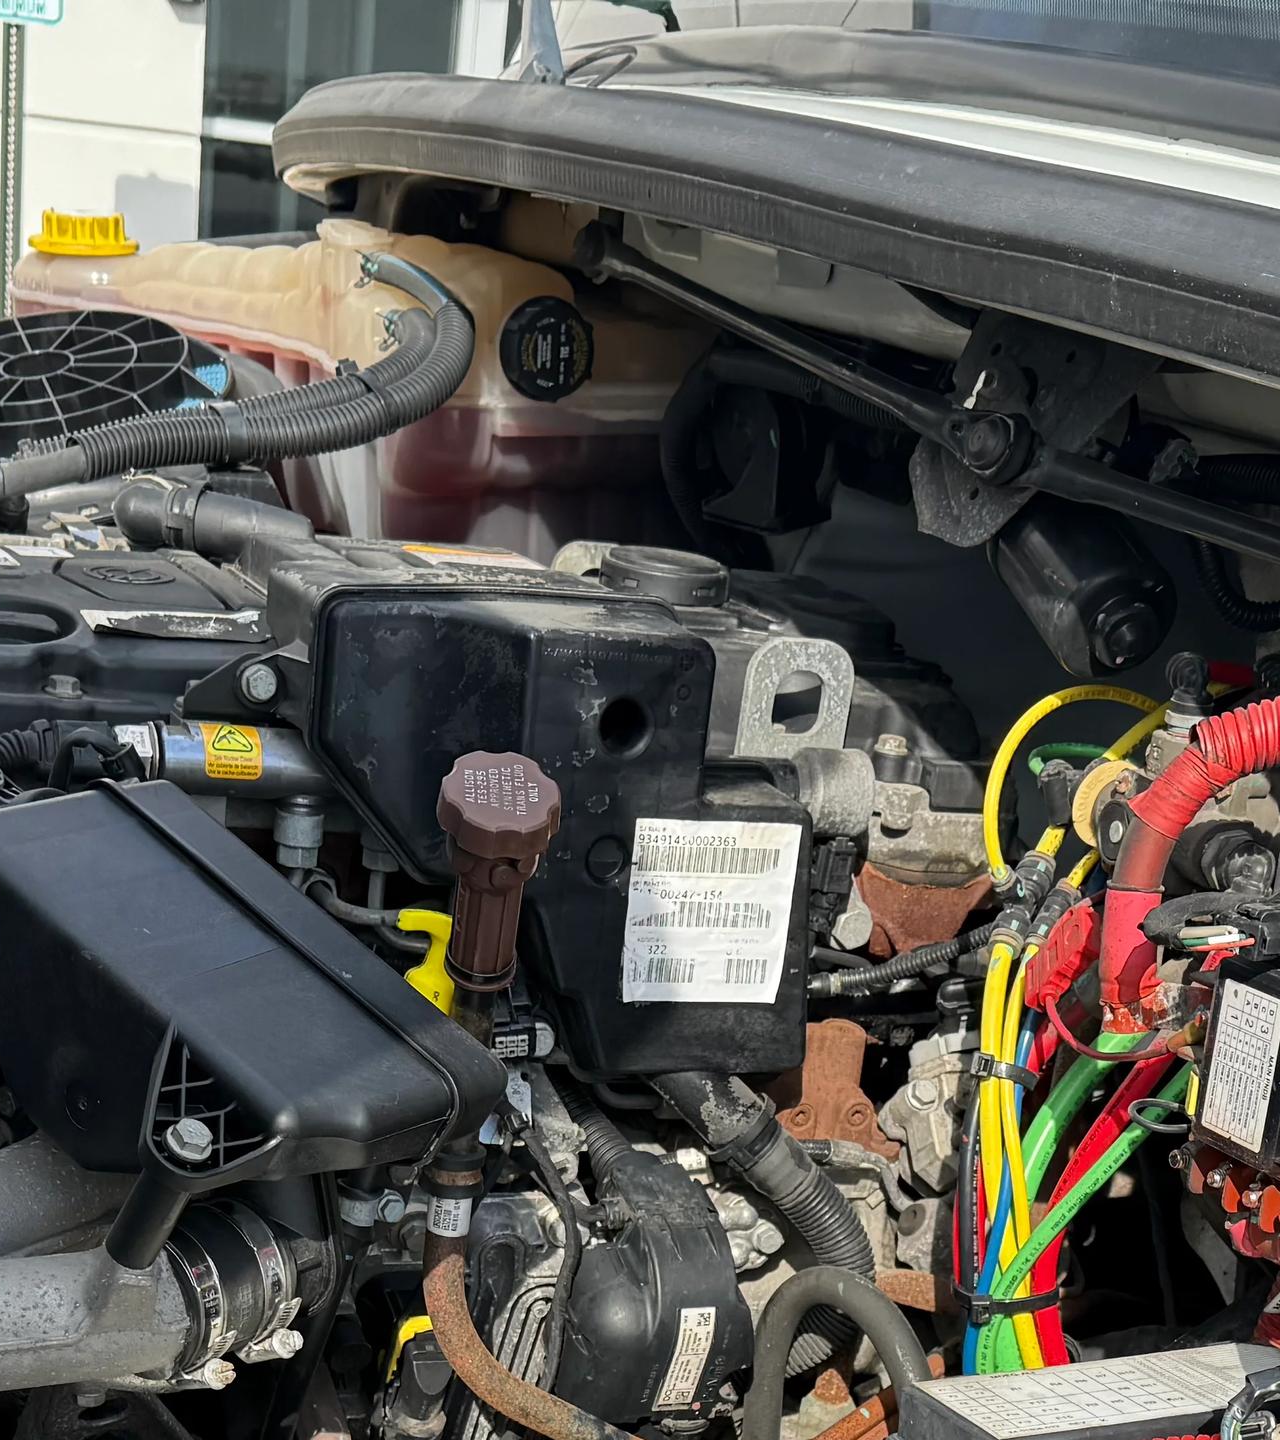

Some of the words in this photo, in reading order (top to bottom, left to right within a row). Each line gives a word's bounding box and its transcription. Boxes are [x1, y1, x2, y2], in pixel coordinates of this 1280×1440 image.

[463, 769, 476, 802] ALLISON
[474, 770, 488, 803] TES-295
[512, 764, 525, 786] FLUID
[487, 768, 501, 807] APPROVED
[500, 766, 514, 810] SYNTHETIC
[526, 781, 539, 802] ONLY
[514, 790, 527, 814] TRANS
[1244, 1017, 1254, 1028] 2
[1259, 1025, 1269, 1035] 3
[1266, 1055, 1275, 1076] MAIN
